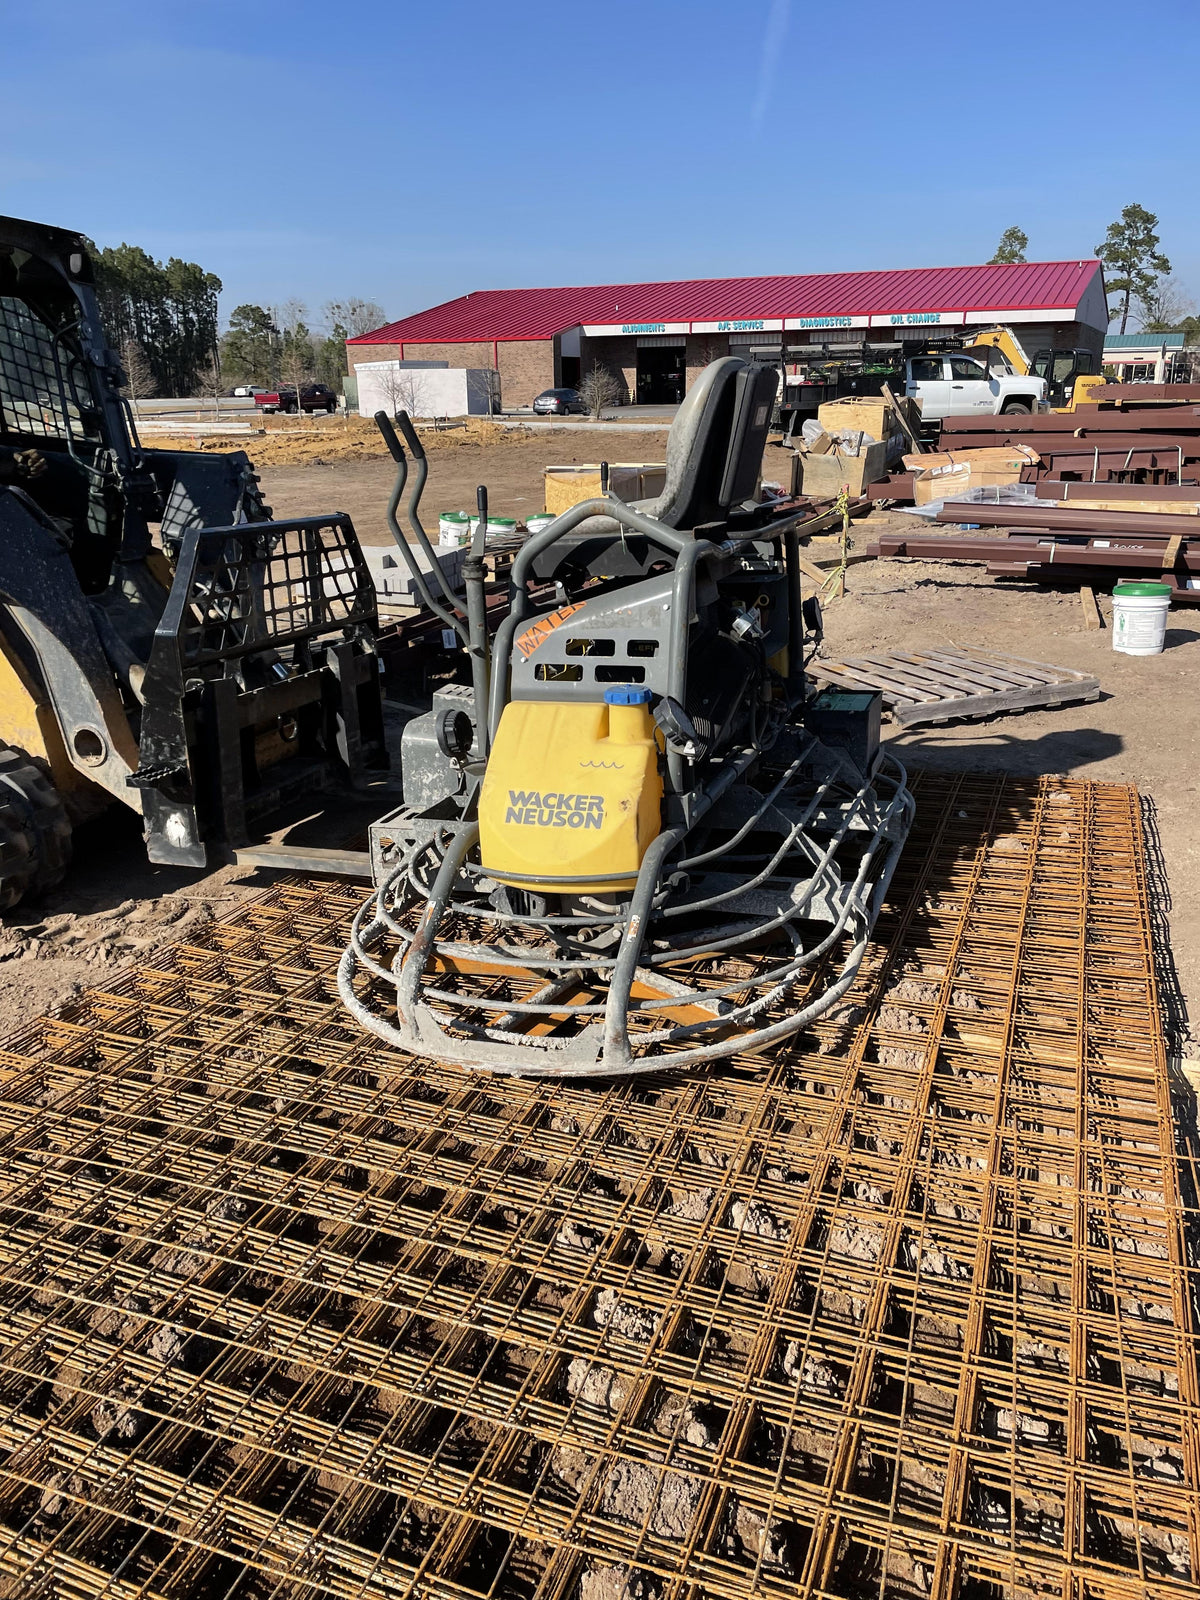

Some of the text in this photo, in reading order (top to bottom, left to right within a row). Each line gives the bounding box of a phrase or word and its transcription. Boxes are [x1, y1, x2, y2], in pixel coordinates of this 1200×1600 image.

[800, 316, 852, 328] DIAGNOSTICS
[890, 312, 941, 324] OIL CHANGE
[622, 323, 666, 333] ALIGNMENTS
[718, 320, 765, 331] A/C SERVICE
[508, 790, 605, 812] WACKER
[505, 808, 604, 830] NEUSON
